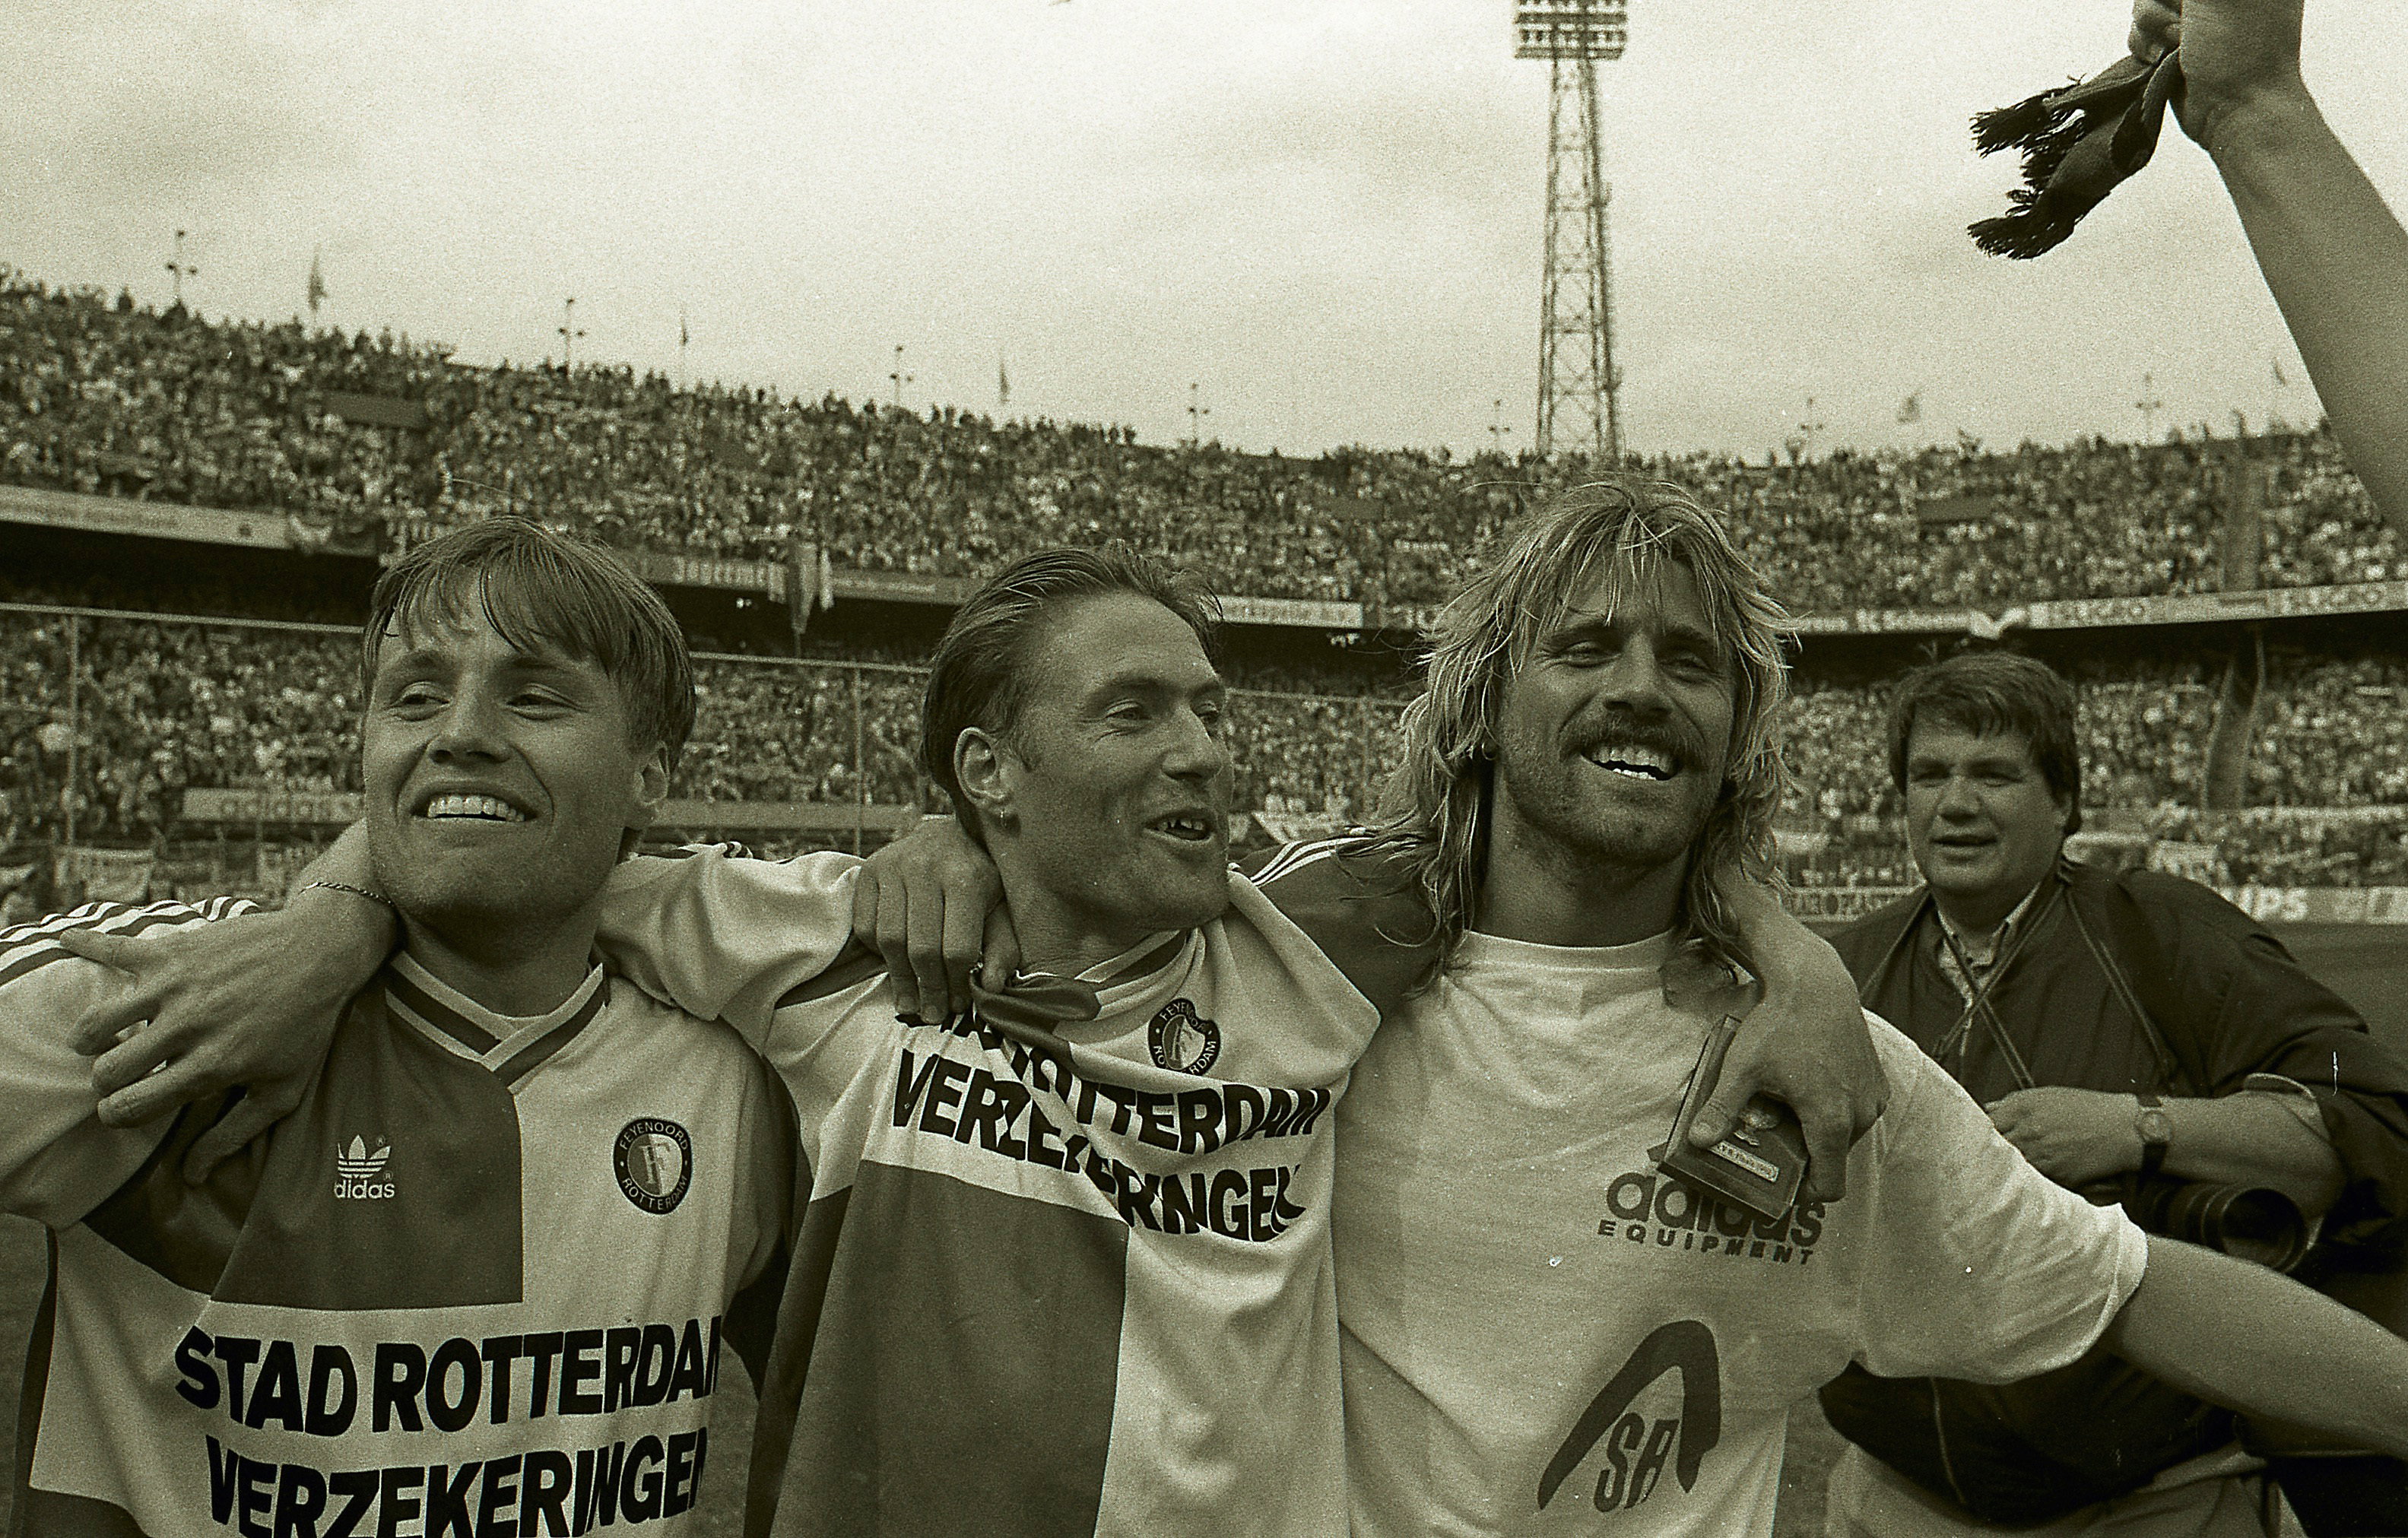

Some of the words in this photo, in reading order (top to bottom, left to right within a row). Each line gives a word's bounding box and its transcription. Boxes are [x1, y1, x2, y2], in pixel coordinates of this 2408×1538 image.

[1153, 1041, 1217, 1074] RORDAM
[619, 1121, 689, 1150] FEYENOORD
[333, 1179, 395, 1200] didas
[622, 1174, 688, 1211] ROTTERDAM
[1597, 1219, 1814, 1265] EQUIPMENT
[173, 1325, 359, 1437] STAD
